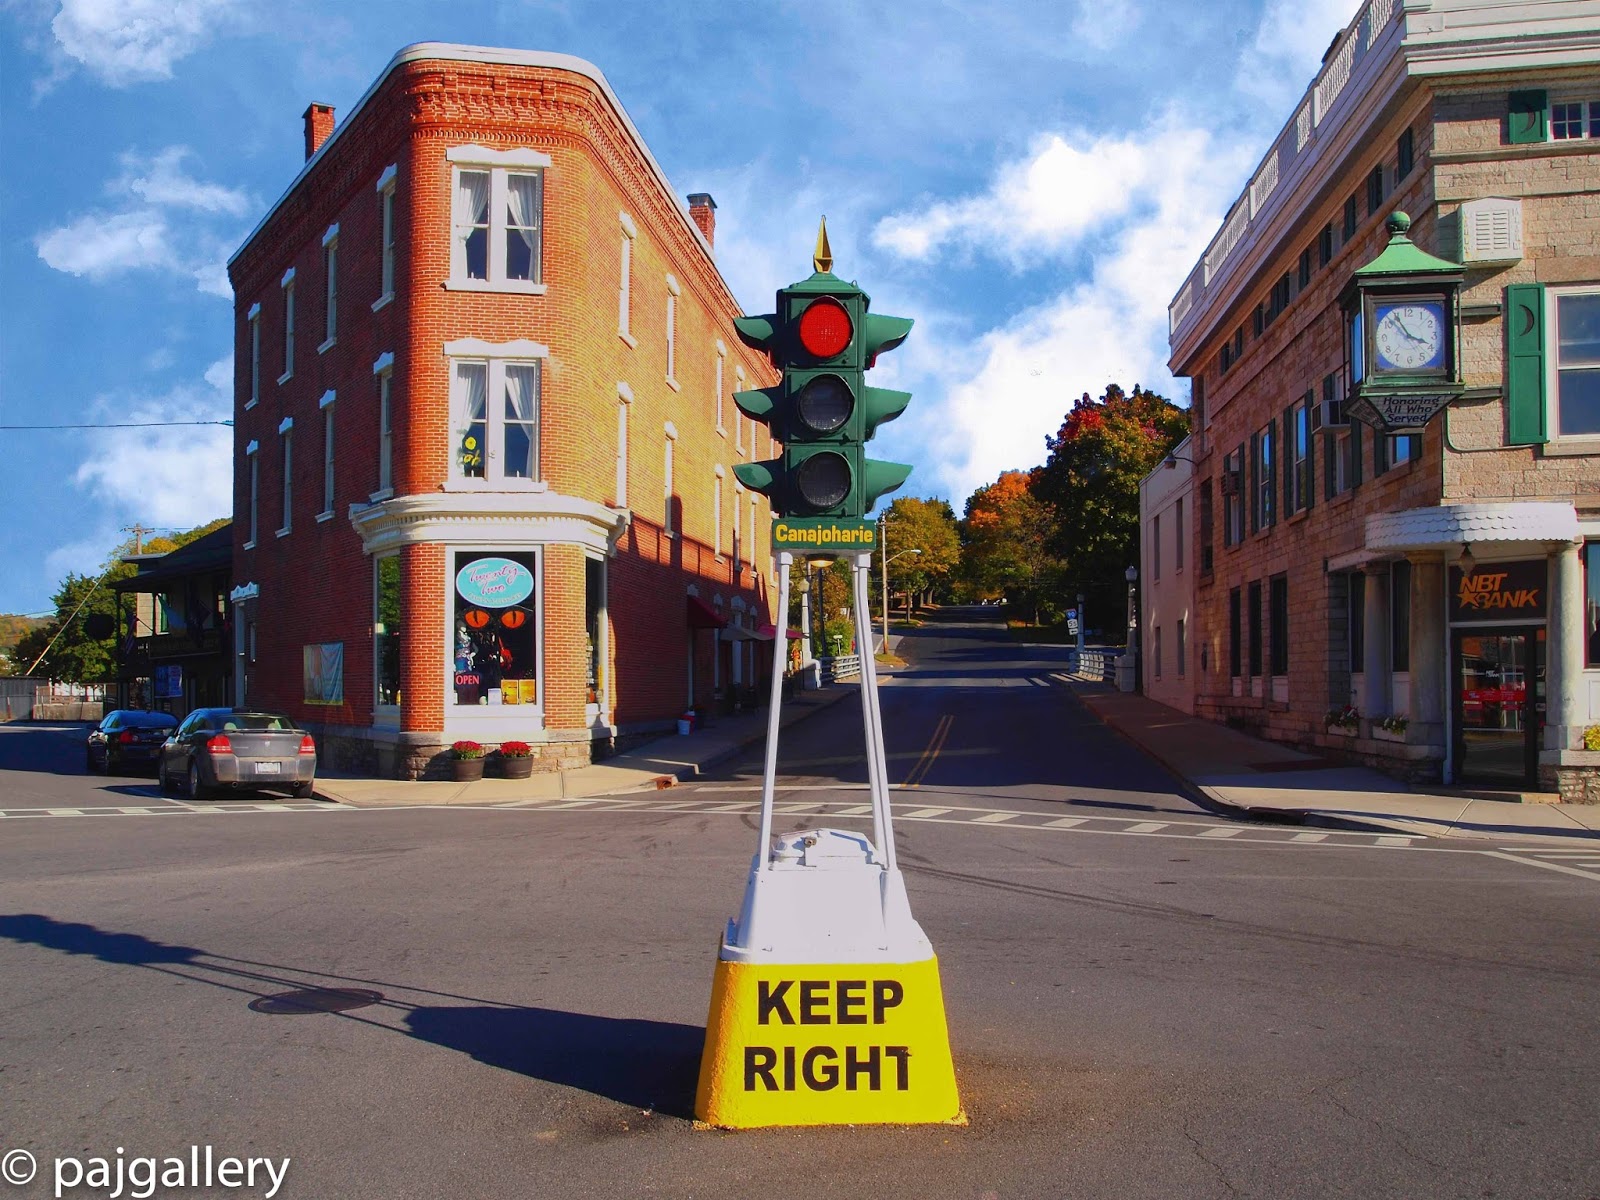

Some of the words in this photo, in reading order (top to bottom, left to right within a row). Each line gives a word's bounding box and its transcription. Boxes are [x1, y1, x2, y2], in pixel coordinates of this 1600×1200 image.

[1404, 308, 1413, 318] 12
[1427, 320, 1433, 329] 2
[1381, 333, 1388, 343] 9
[1431, 332, 1438, 341] 3
[1385, 345, 1392, 354] 8
[1427, 344, 1435, 353] 4
[1394, 353, 1400, 363] 7
[1406, 355, 1413, 365] 6
[1418, 352, 1426, 362] 5
[1383, 396, 1441, 408] Honoring
[1385, 405, 1401, 414] All
[1407, 405, 1432, 414] Who
[1387, 413, 1427, 423] Served
[776, 524, 873, 546] Canajoharie
[466, 563, 526, 585] Twenty
[478, 580, 506, 595] Two
[1460, 573, 1508, 593] NBT
[1472, 589, 1539, 609] BANK
[456, 674, 480, 685] OPEN
[757, 981, 904, 1024] KEEP
[744, 1045, 909, 1092] RIGHT
